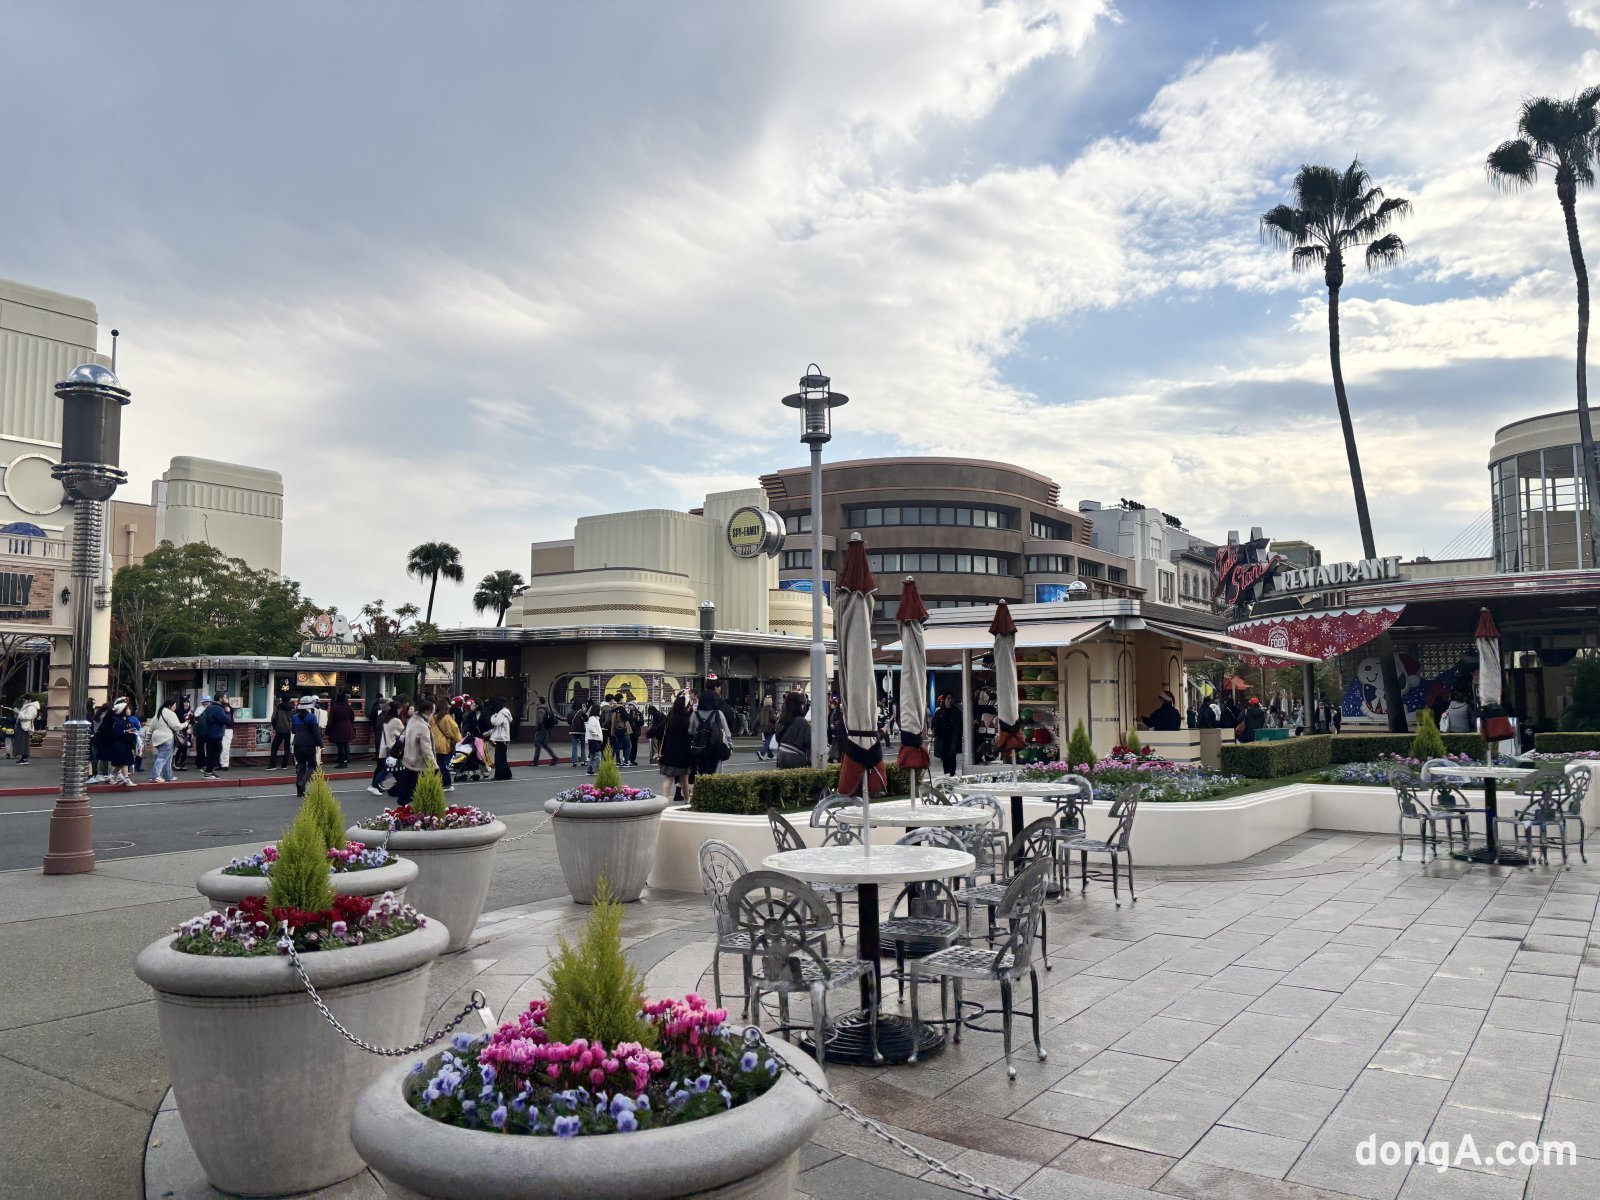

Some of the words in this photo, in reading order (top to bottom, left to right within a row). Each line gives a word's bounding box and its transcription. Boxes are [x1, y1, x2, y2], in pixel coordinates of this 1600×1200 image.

[1229, 554, 1281, 605] Stars
[1281, 556, 1402, 590] RESTAURANT
[342, 645, 357, 654] STAND
